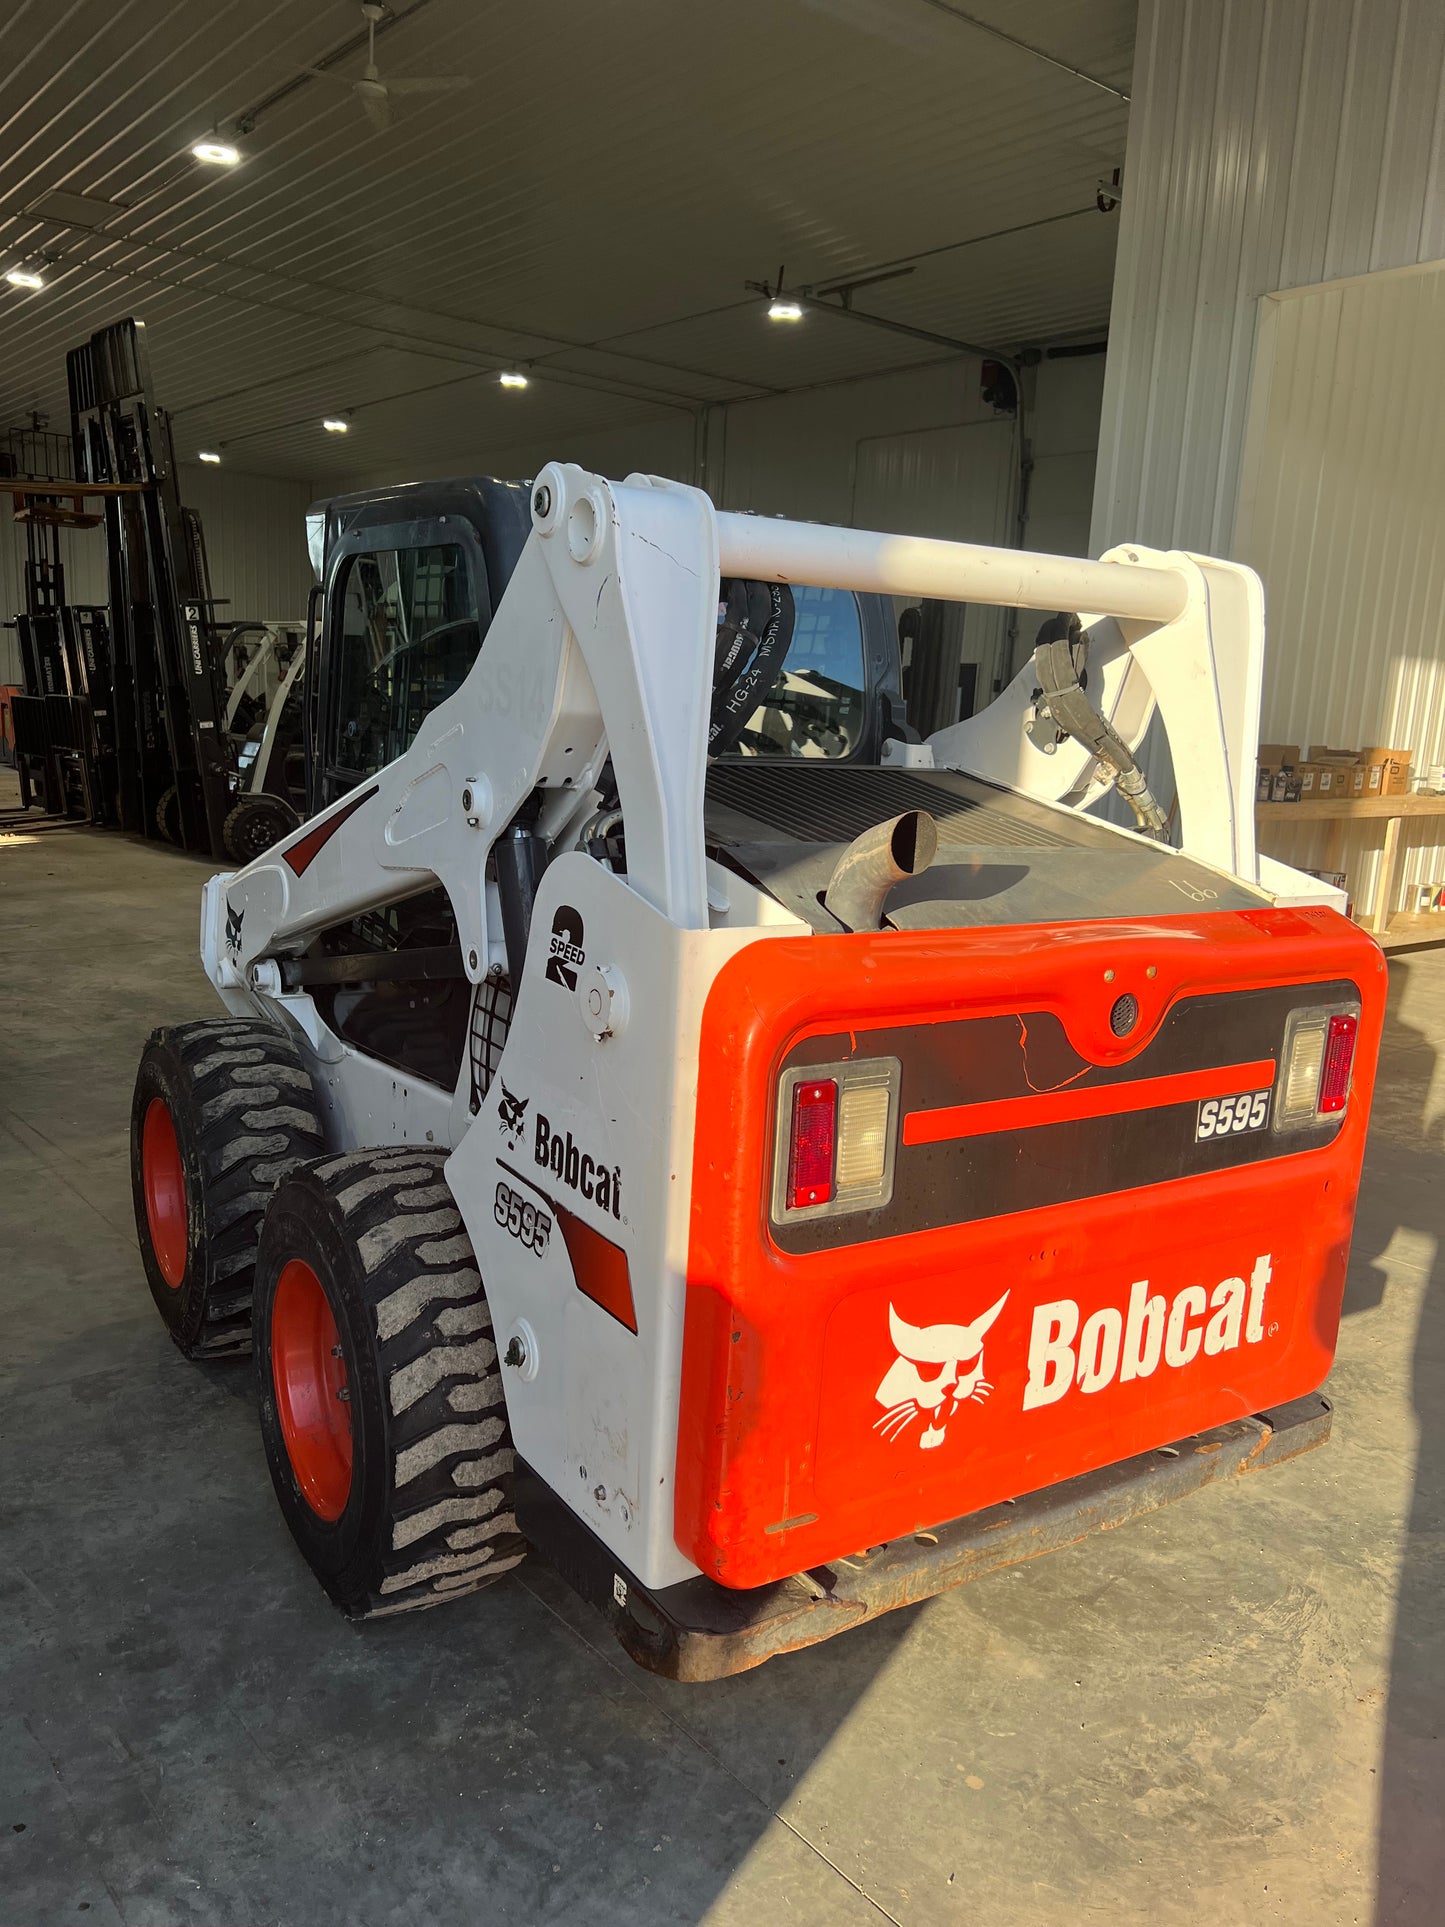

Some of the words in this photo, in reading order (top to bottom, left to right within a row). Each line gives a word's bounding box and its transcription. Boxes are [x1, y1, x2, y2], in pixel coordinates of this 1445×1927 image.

[186, 606, 198, 620] 2
[726, 668, 762, 714] HG-24
[544, 905, 585, 992] 2
[549, 937, 586, 966] SPEED
[1198, 1091, 1268, 1138] S595
[534, 1112, 622, 1220] Bobcat
[493, 1181, 552, 1258] S595
[1022, 1253, 1273, 1412] Bobcat
